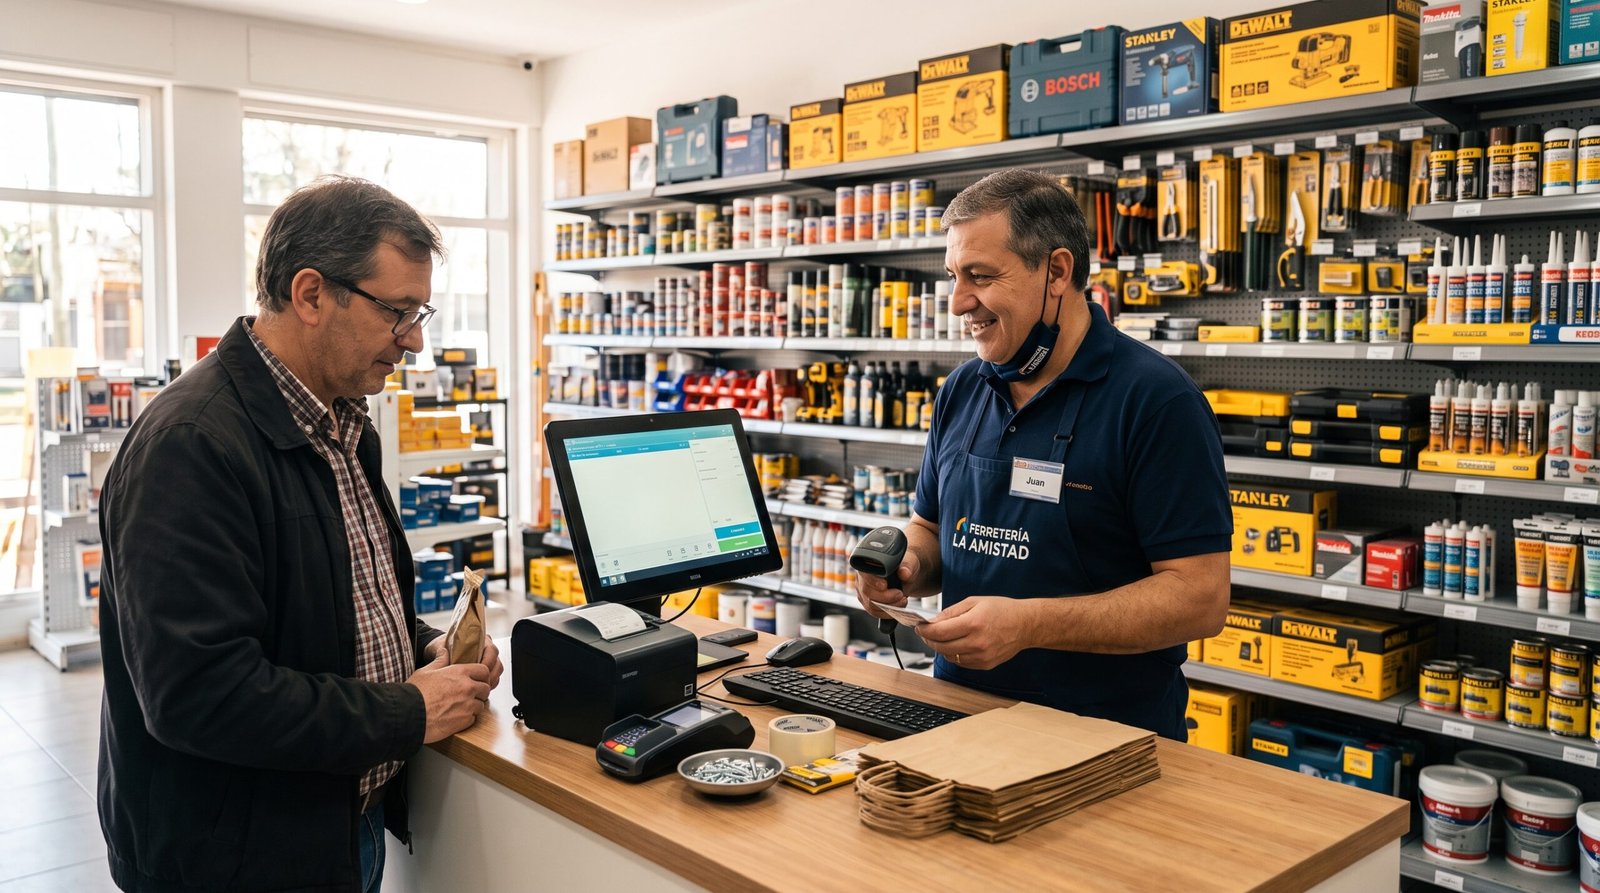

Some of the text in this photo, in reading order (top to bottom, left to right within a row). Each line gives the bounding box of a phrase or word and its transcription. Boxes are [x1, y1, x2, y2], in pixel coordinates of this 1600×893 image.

[1125, 28, 1176, 48] STANLEY
[1044, 71, 1100, 96] BOSCH
[1026, 476, 1045, 487] Juan
[1229, 490, 1290, 507] TANLEY
[969, 523, 1030, 543] FERRETERÍA
[952, 533, 1030, 560] LA AMISTAD
